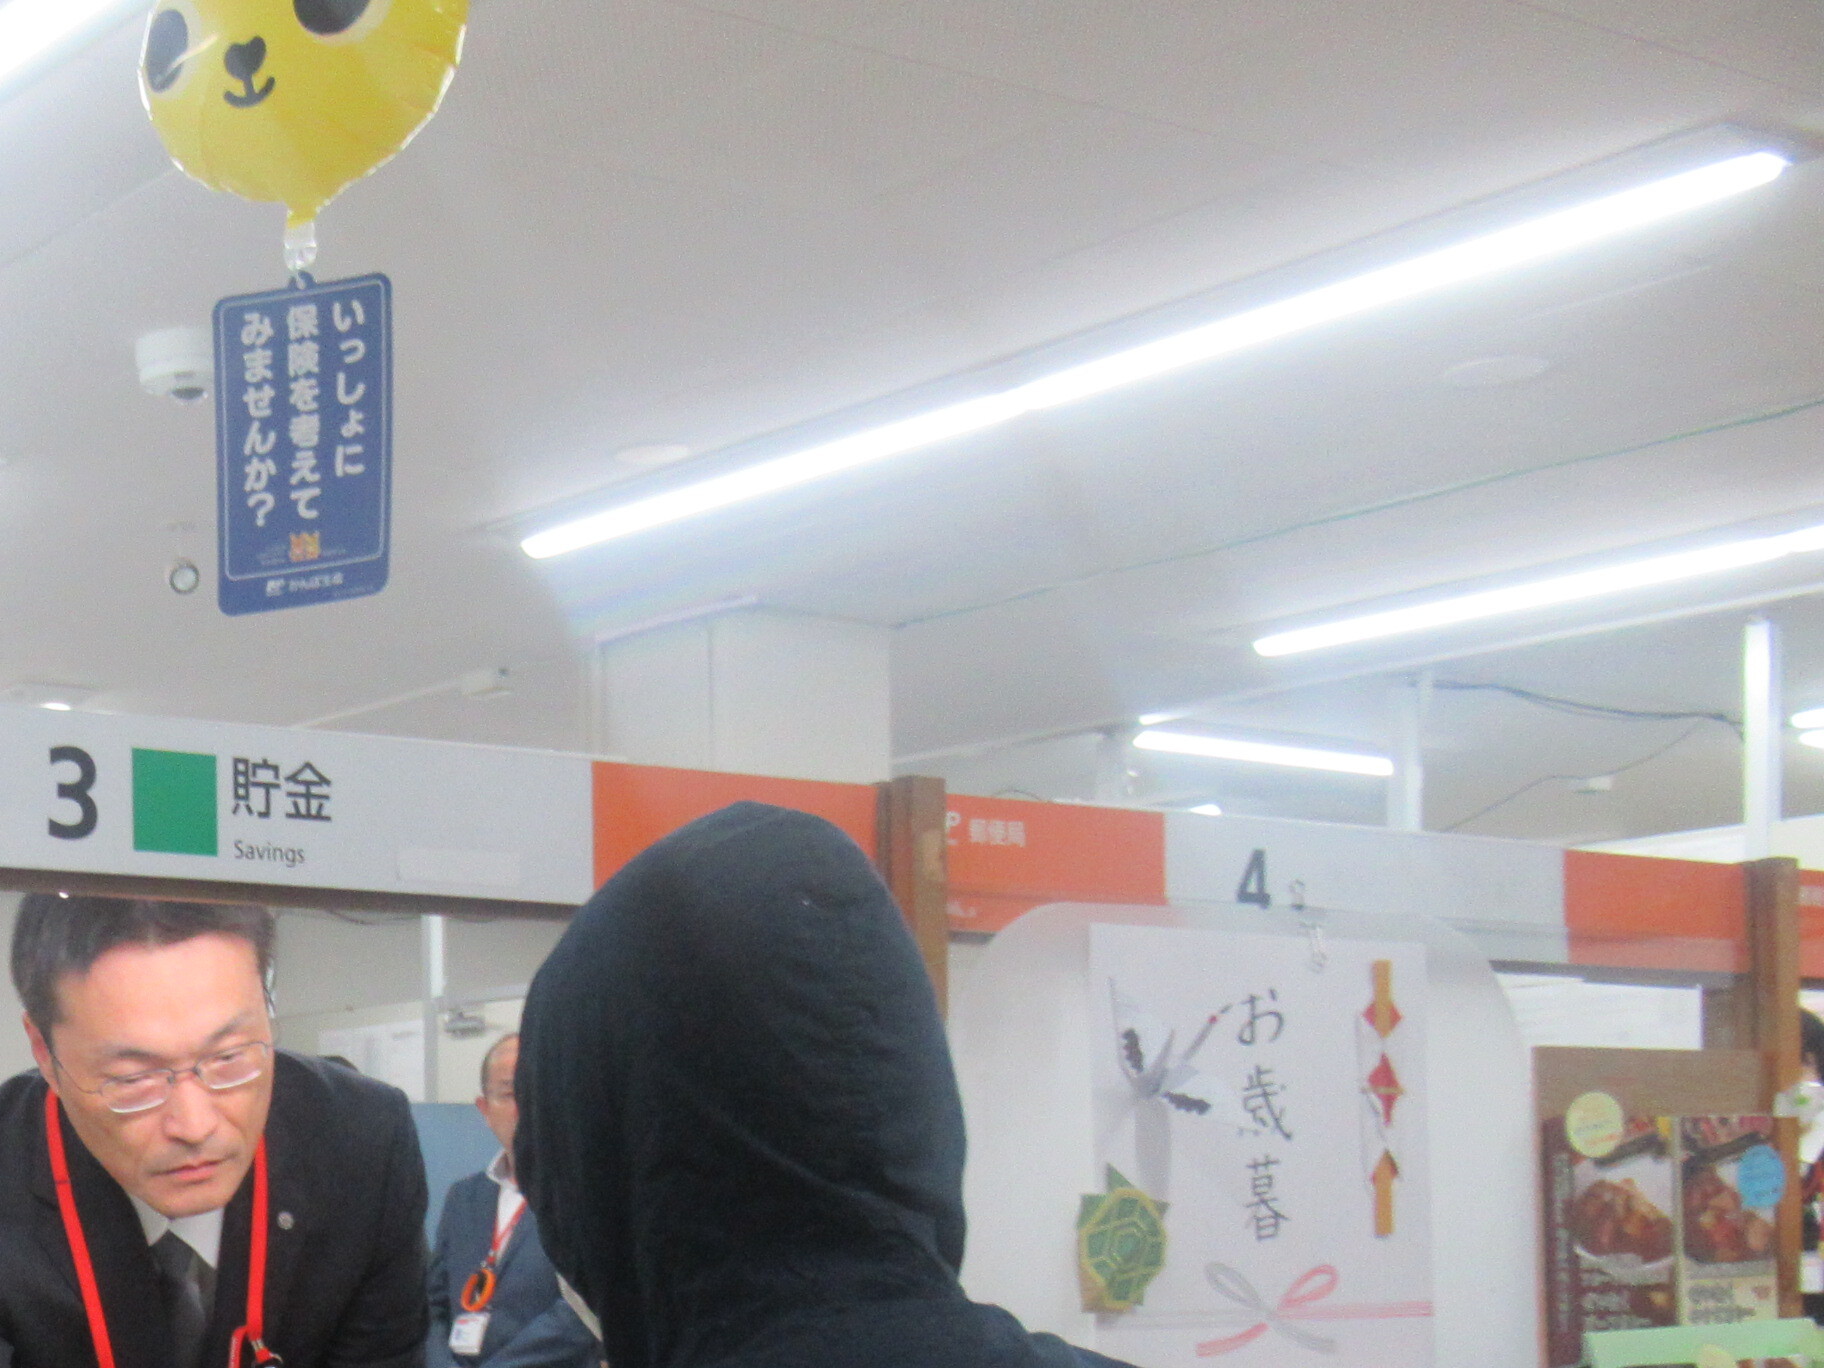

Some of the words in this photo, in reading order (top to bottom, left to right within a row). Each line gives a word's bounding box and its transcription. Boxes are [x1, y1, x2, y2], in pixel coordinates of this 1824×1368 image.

[285, 302, 322, 521] 保険を考えて
[332, 299, 366, 478] いっしょに
[48, 744, 98, 840] 3
[232, 757, 332, 822] 貯金
[234, 841, 305, 868] Savings
[1237, 848, 1271, 909] 4
[1237, 988, 1292, 1241] お歳暮
